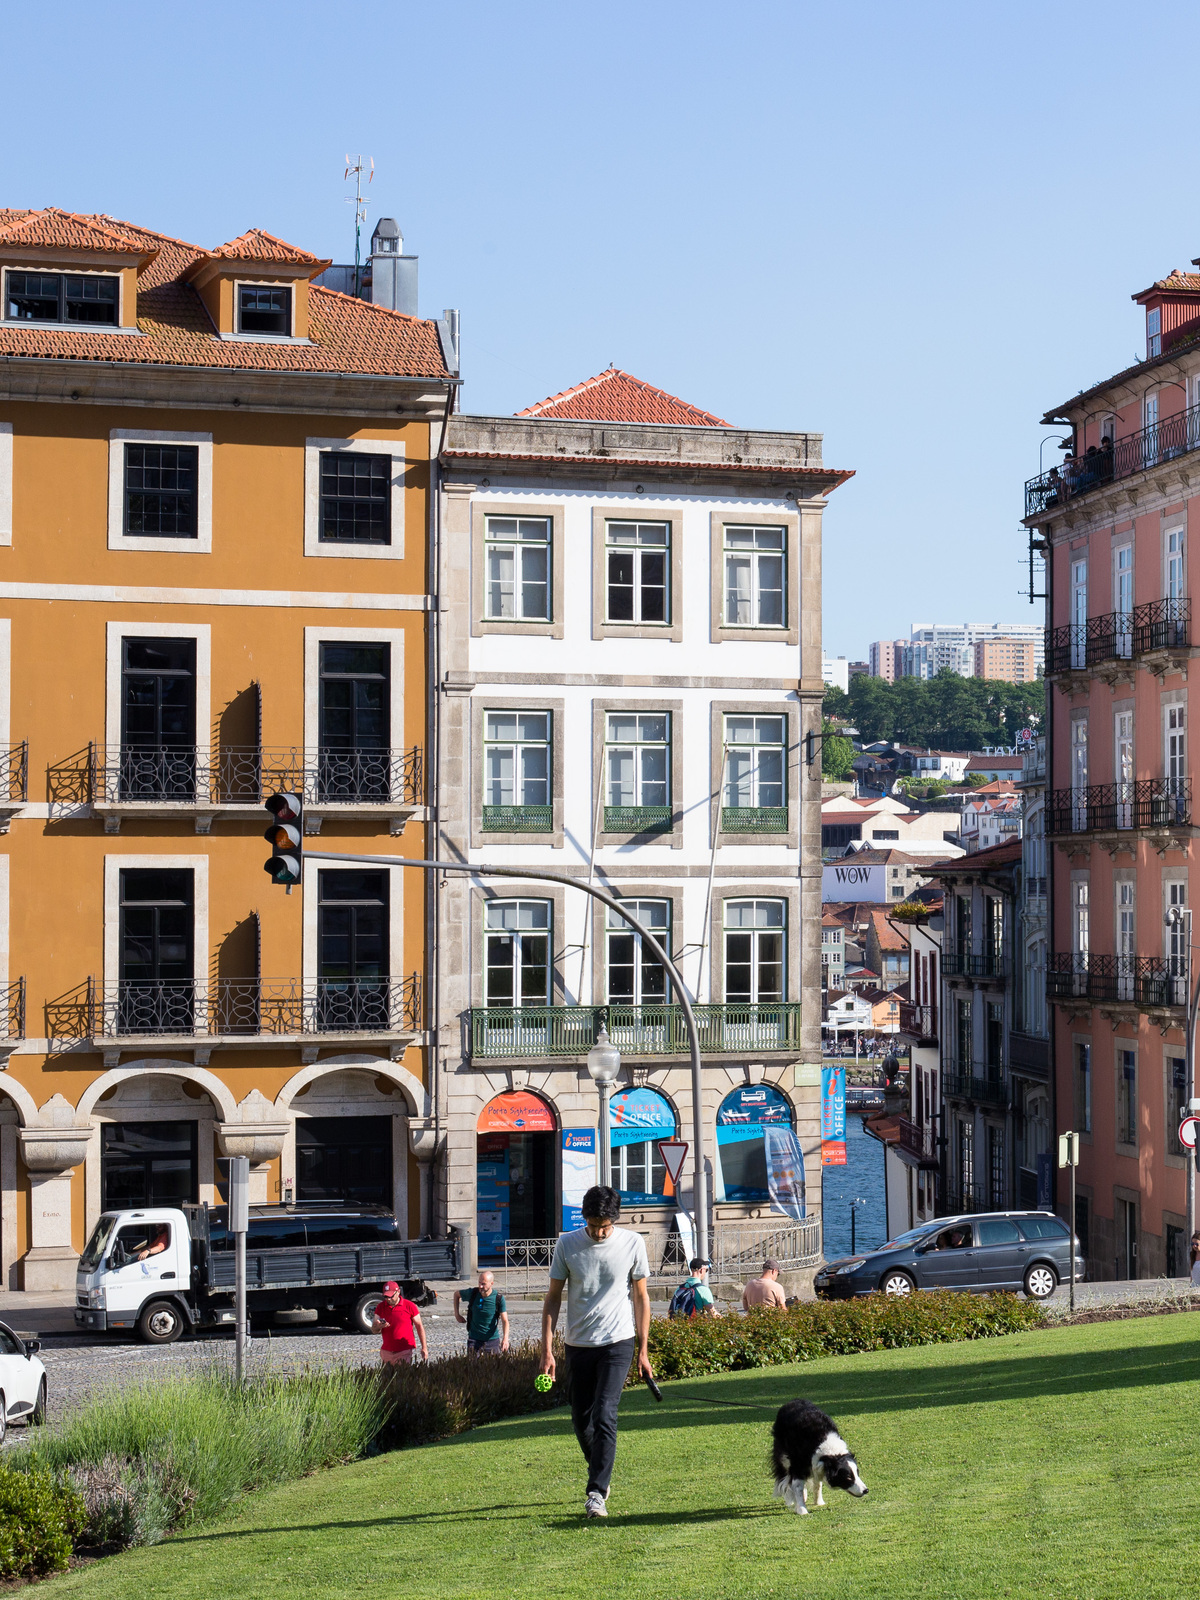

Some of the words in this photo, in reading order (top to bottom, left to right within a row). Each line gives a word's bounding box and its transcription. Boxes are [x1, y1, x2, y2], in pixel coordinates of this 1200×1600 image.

[835, 867, 871, 884] WOW
[488, 1106, 507, 1114] Porto
[510, 1106, 548, 1116] Sightseeing
[824, 1097, 832, 1137] TICKET
[834, 1096, 843, 1137] OFFICE
